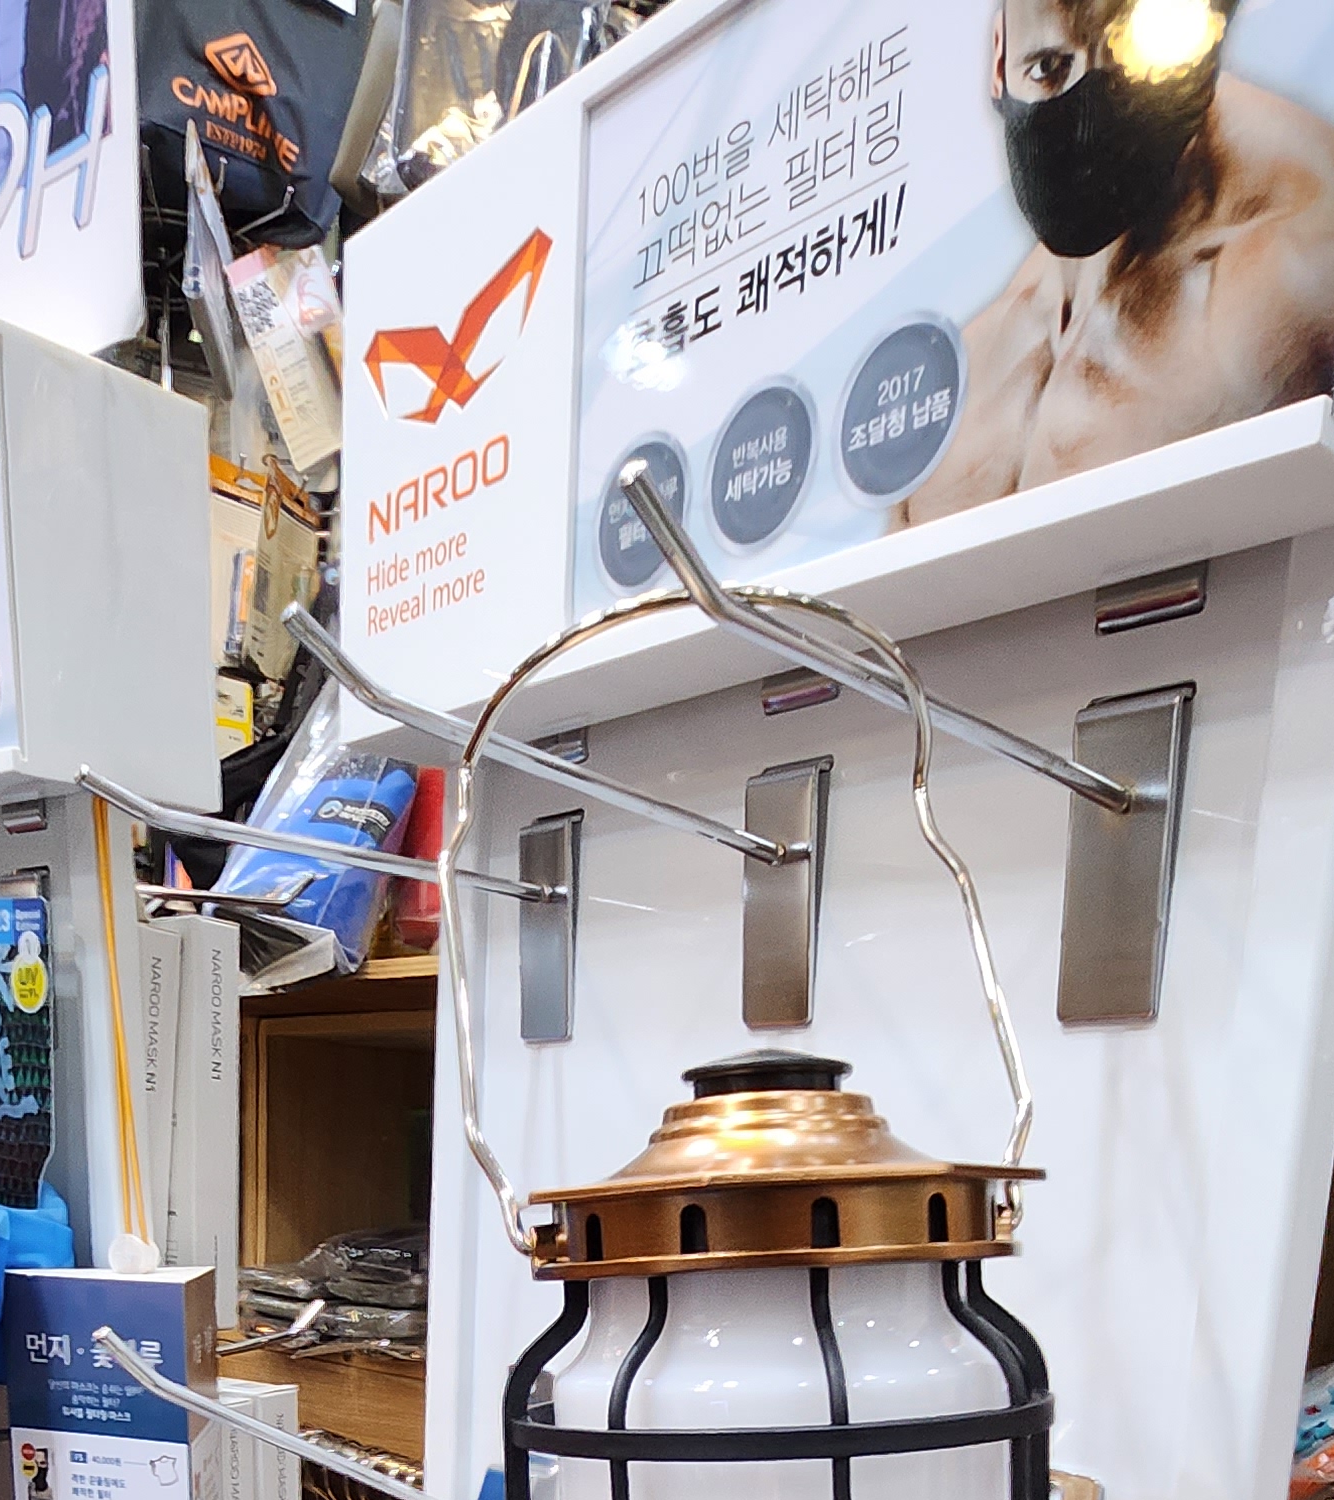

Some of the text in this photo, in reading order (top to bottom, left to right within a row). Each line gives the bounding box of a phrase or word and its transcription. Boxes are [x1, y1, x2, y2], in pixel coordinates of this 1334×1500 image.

[637, 24, 911, 228] 100번을 세탁해도
[785, 88, 906, 210] 필터링
[736, 181, 910, 317] 쾌적하게!
[877, 365, 926, 405] 2017
[731, 425, 788, 468] 반복사용
[847, 386, 952, 453] 조달청 납품
[368, 434, 510, 545] NAROO
[723, 457, 794, 504] 세탁가능
[367, 529, 468, 598] Hide more
[367, 567, 486, 638] Reveal more
[148, 956, 162, 1017] NAROO
[210, 949, 223, 1009] NAROO
[146, 1020, 160, 1069] MASK
[210, 1010, 223, 1058] MASK
